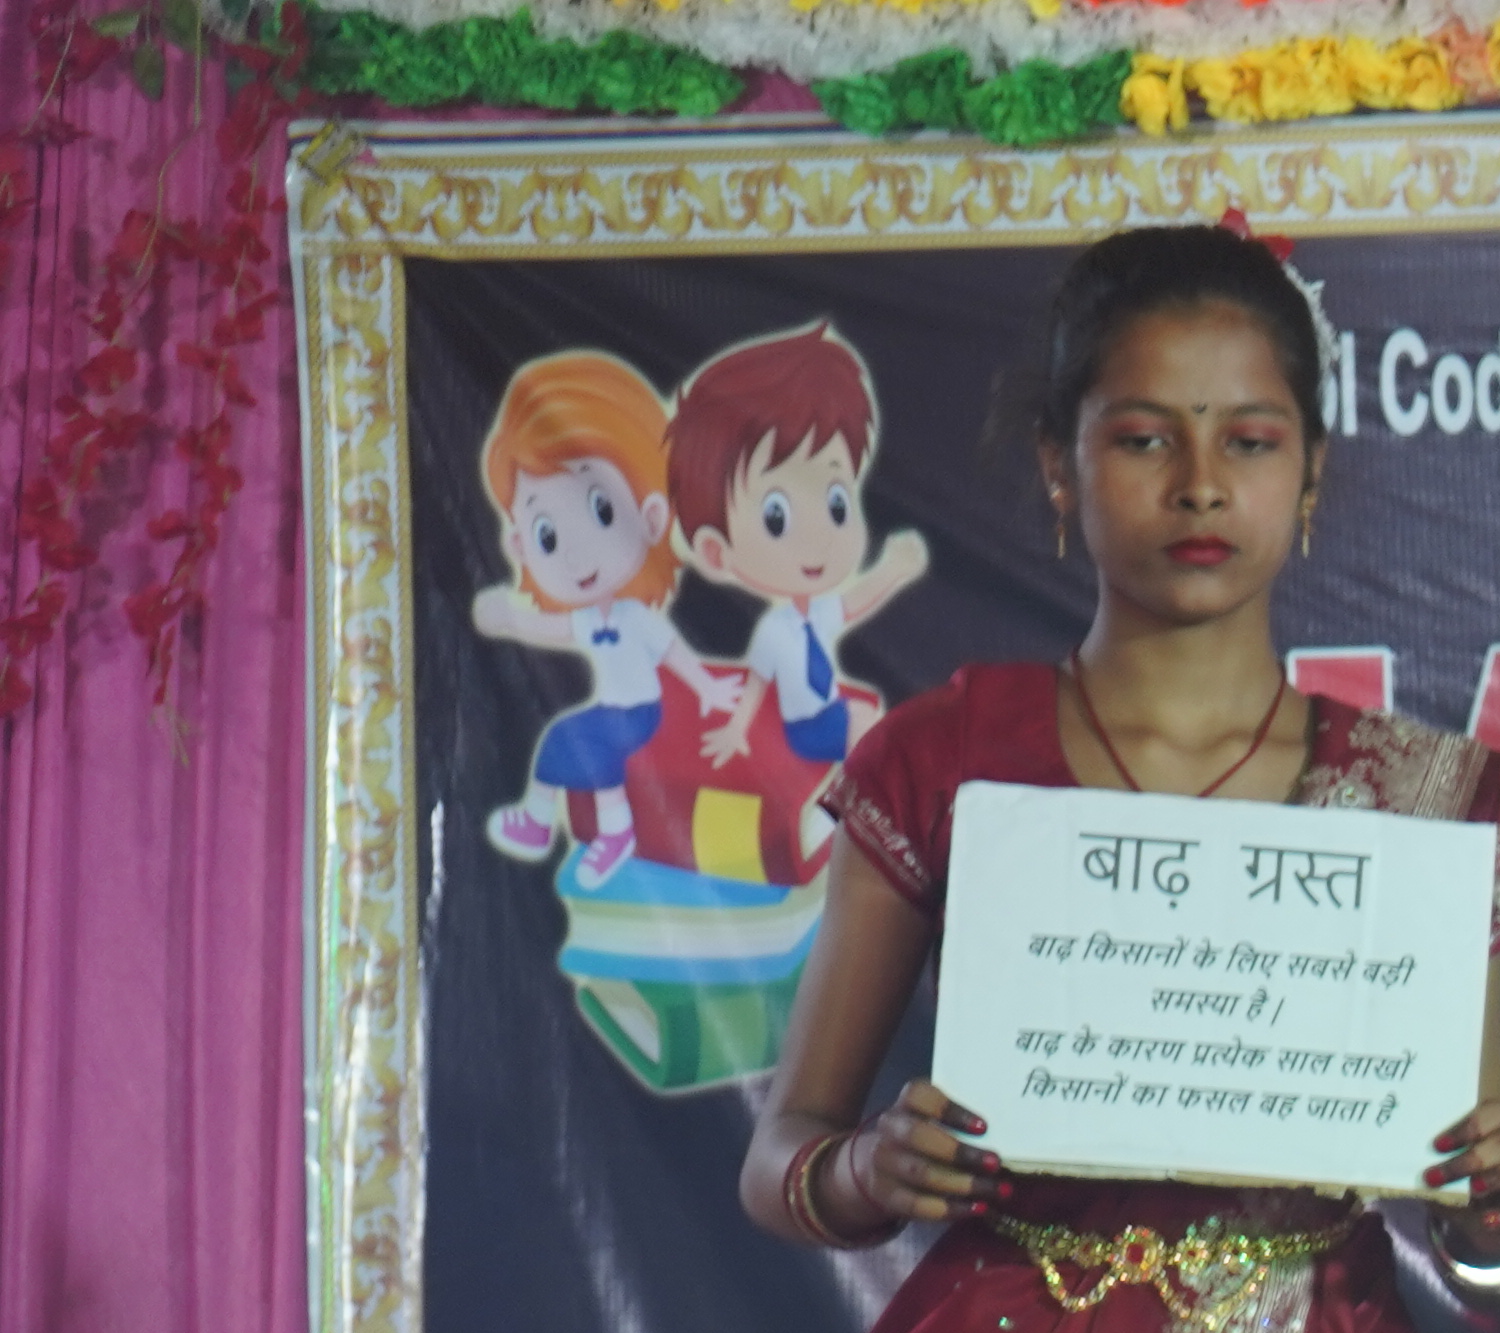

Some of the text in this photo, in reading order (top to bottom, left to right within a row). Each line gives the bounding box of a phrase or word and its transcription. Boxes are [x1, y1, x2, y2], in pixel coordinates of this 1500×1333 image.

[1079, 832, 1371, 910] बाढ़ ग्रस्त
[1082, 930, 1190, 967] किसानों
[1193, 937, 1223, 968] के
[1226, 942, 1281, 979] लिए
[1288, 949, 1357, 982] सबसे
[1152, 988, 1242, 1016] समस्या
[1072, 1024, 1102, 1056] के
[1108, 1034, 1187, 1063] कारण
[1192, 1033, 1272, 1068] प्रत्येक
[1278, 1047, 1334, 1075] साल
[1132, 1082, 1171, 1108] का
[1177, 1084, 1253, 1115] फसल
[1260, 1092, 1301, 1121] बह
[1306, 1095, 1371, 1123] जाता
[1375, 1091, 1399, 1128] है
